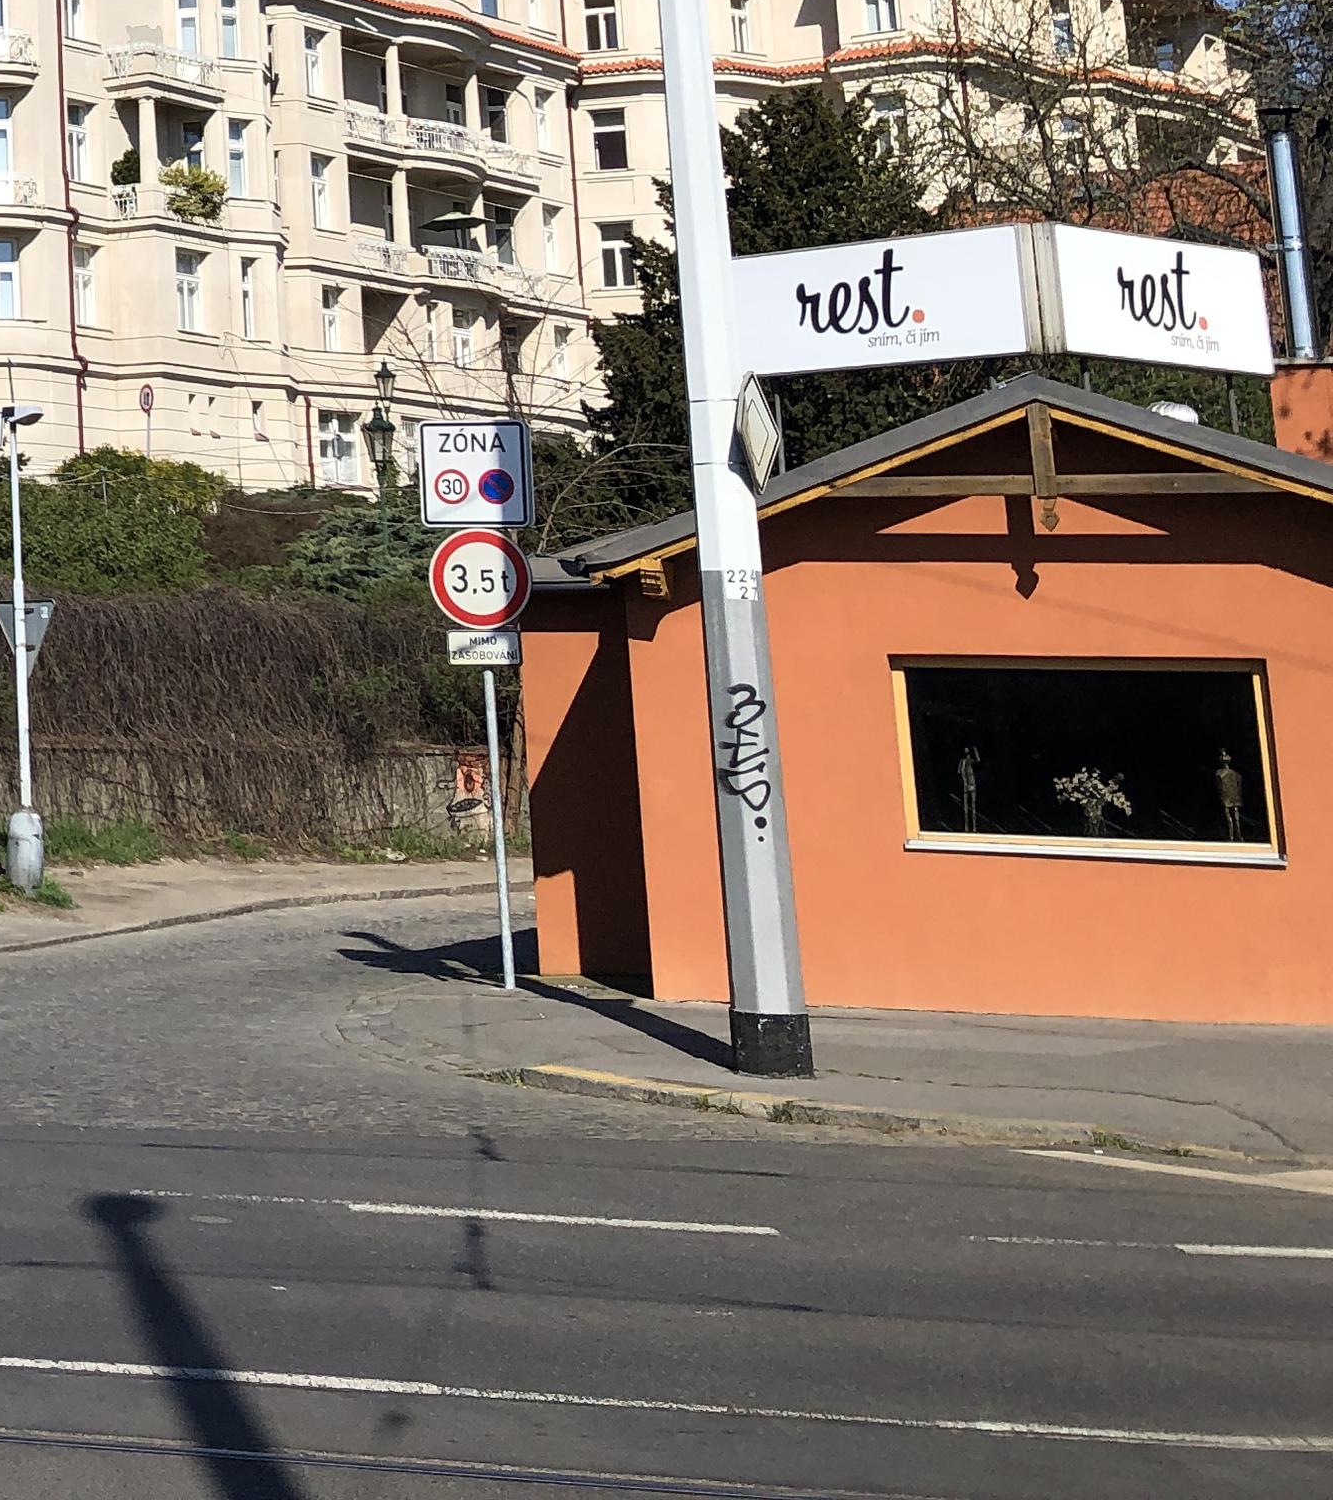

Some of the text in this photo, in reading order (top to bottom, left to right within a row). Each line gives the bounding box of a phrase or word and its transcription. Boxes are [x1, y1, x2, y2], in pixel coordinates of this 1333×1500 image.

[905, 330, 916, 344] či
[919, 328, 940, 347] jím
[438, 429, 506, 453] ZÓNA
[442, 479, 463, 495] 30
[450, 564, 511, 595] 3,5 t
[726, 569, 758, 583] 224
[469, 637, 497, 646] MIMO
